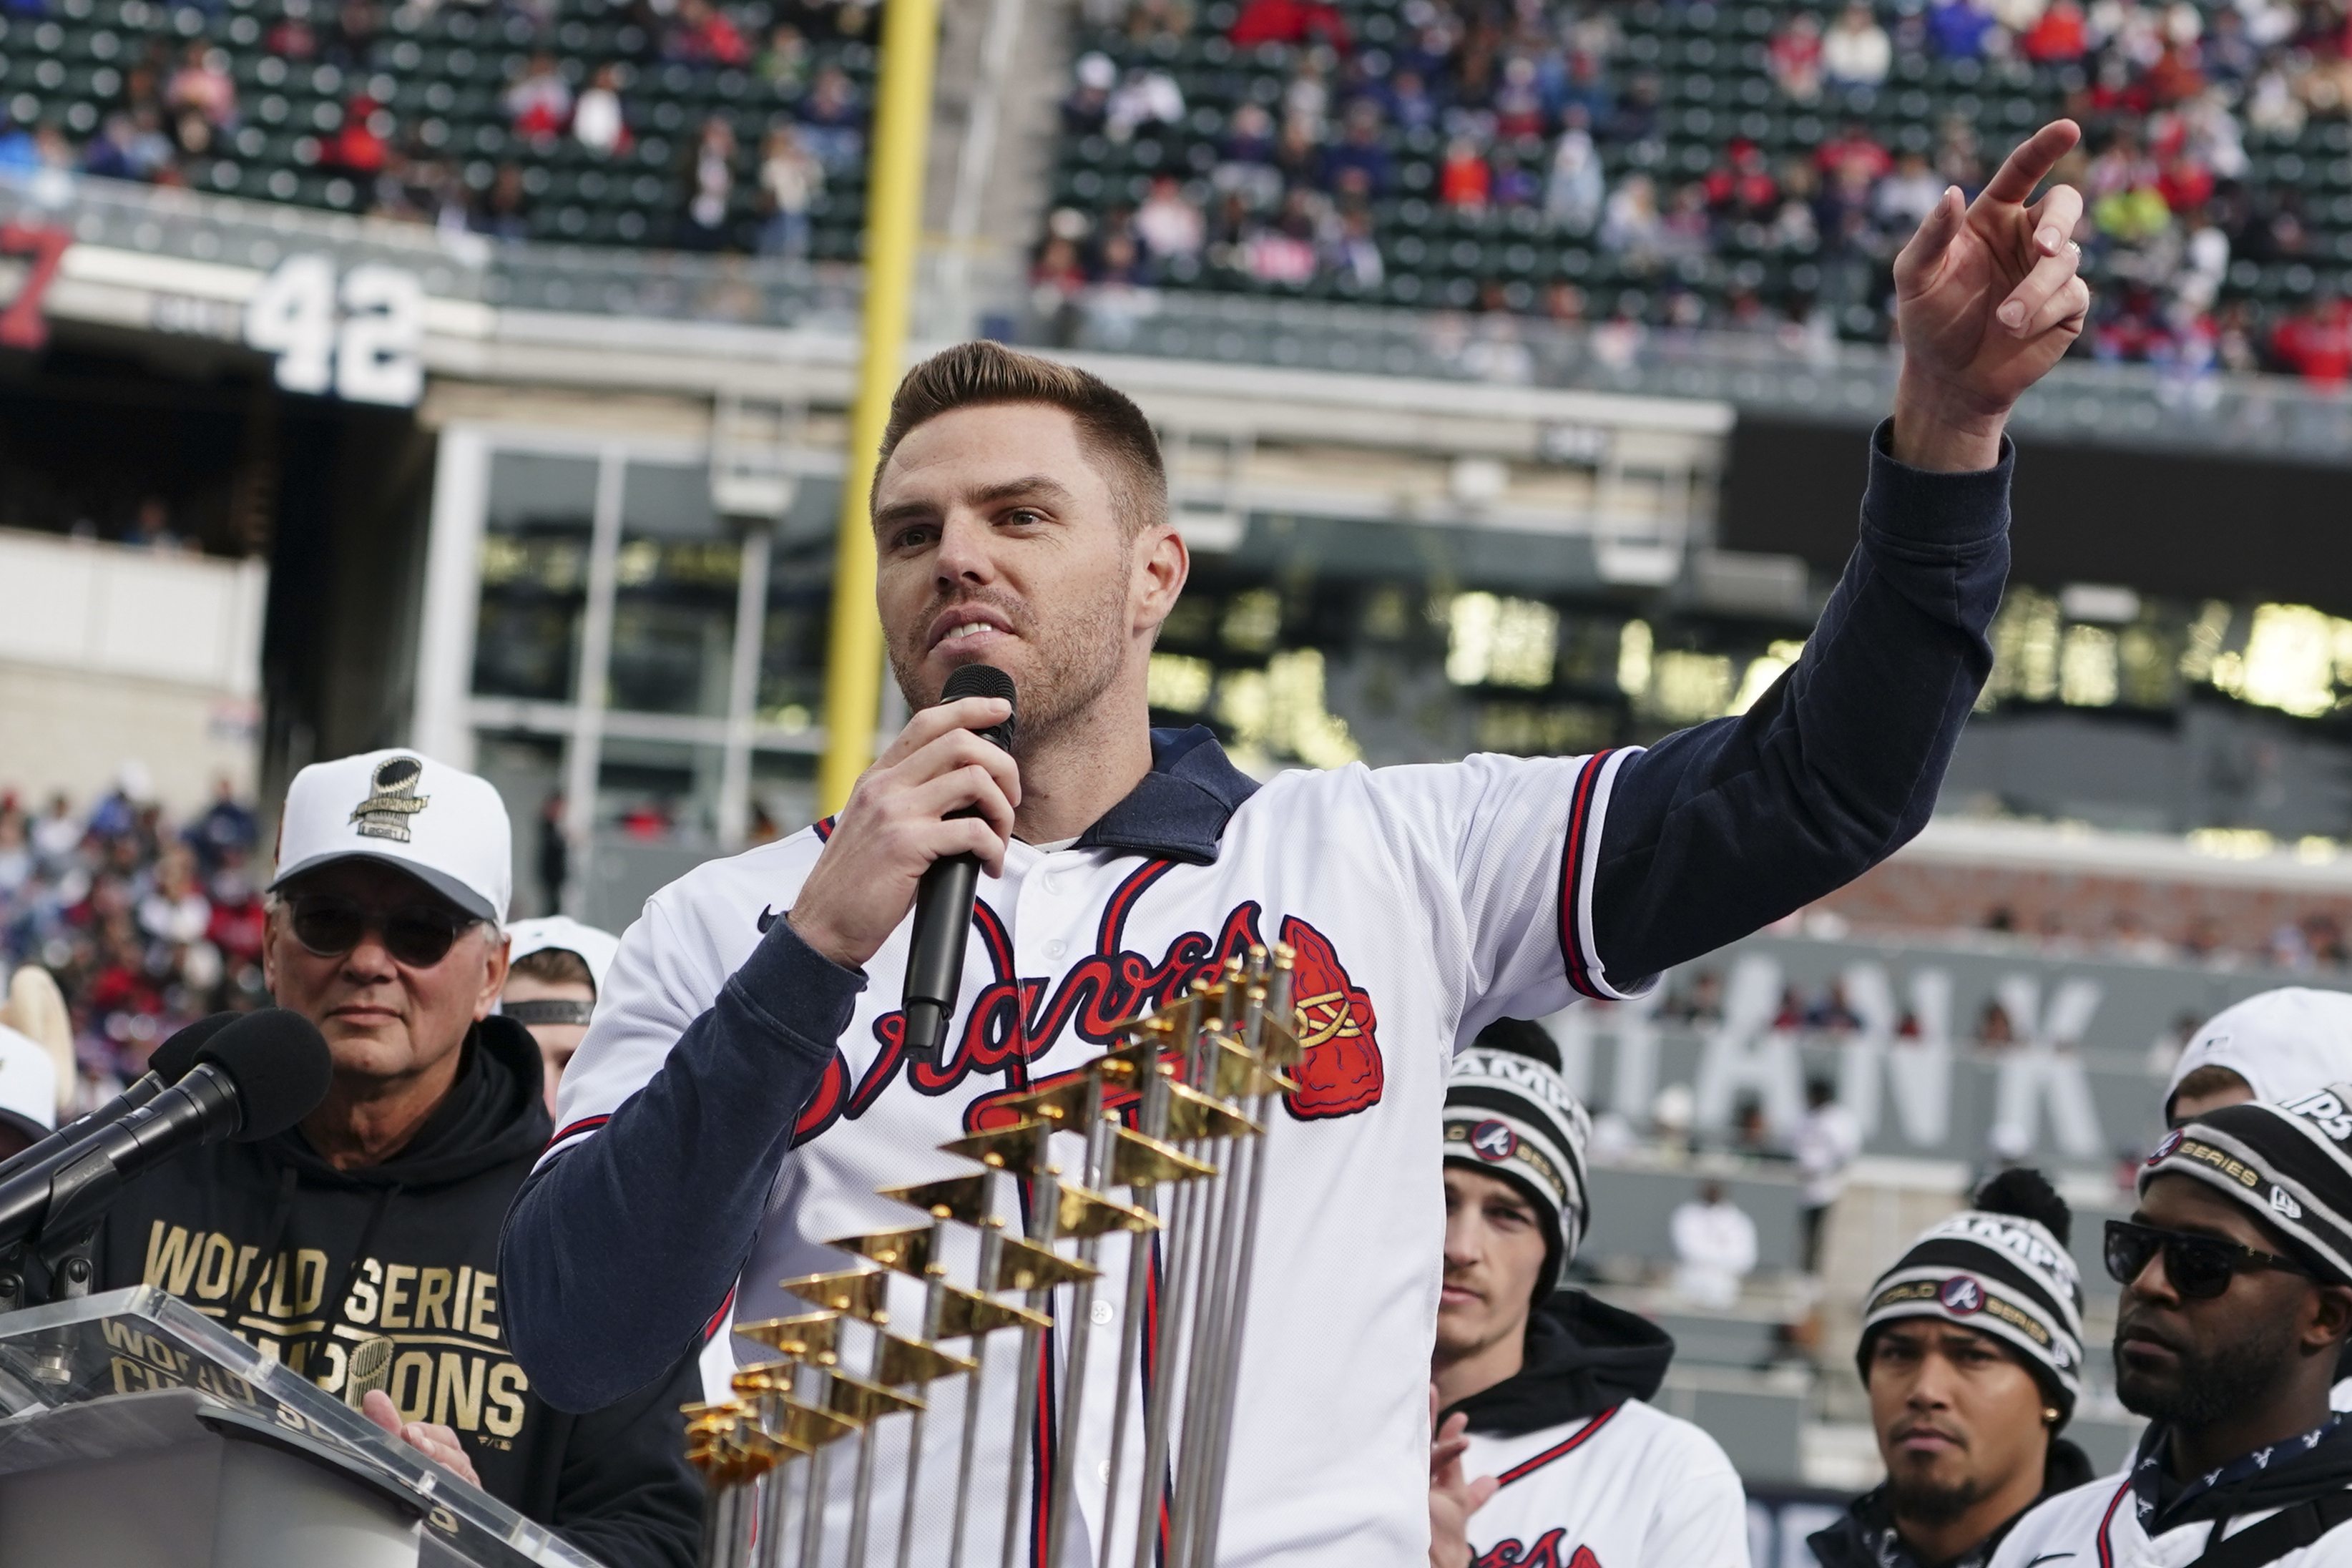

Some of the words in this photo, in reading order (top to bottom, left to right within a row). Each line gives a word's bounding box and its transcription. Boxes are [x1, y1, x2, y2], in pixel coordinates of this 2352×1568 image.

[243, 252, 424, 407] 42
[789, 899, 1261, 1150] raves
[2178, 1142, 2259, 1187] SERIES
[344, 1257, 500, 1341] SERIE
